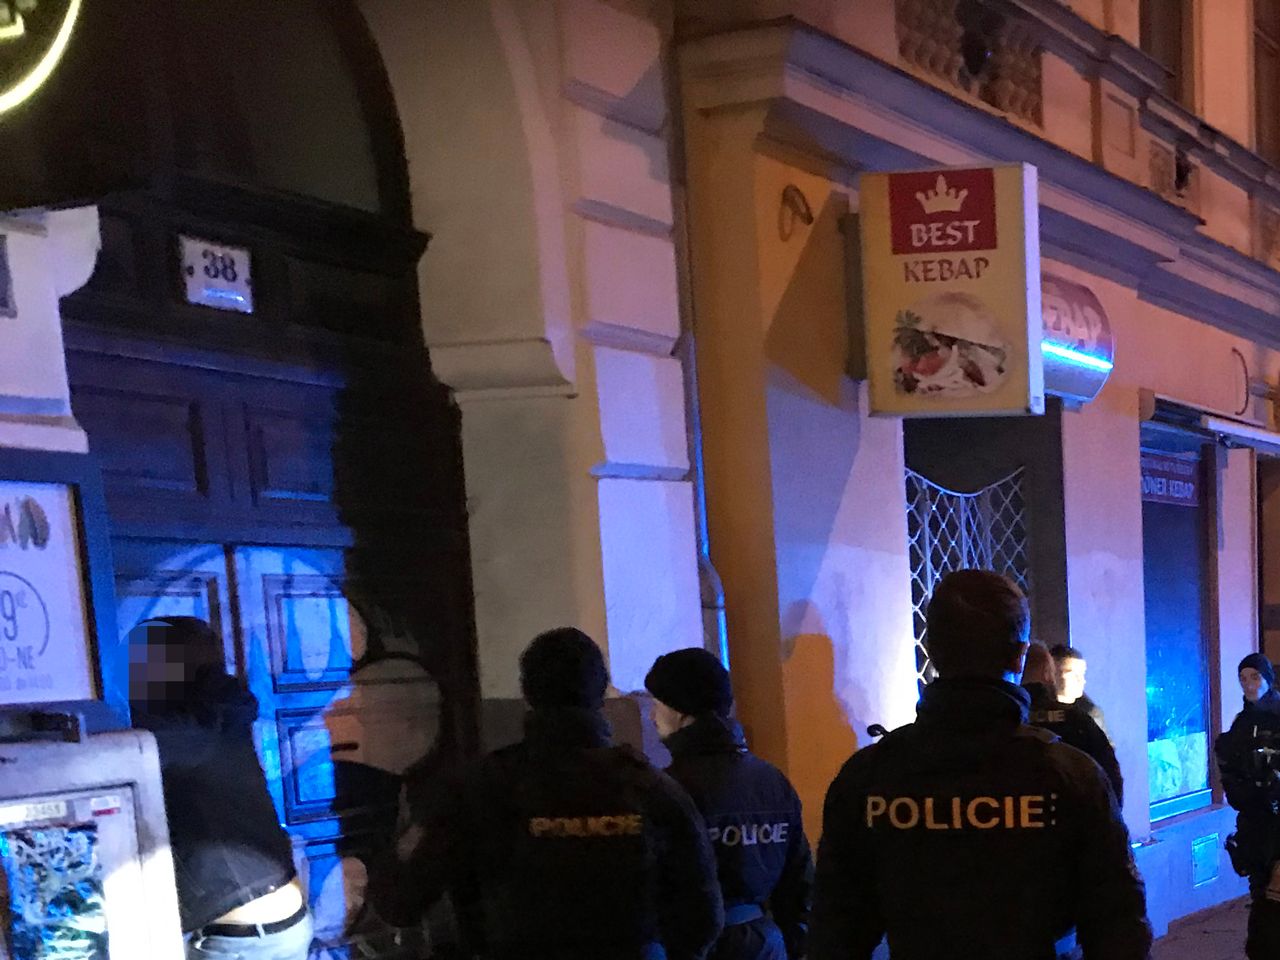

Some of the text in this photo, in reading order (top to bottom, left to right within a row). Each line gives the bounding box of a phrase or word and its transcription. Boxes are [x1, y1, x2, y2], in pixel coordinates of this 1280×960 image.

[909, 220, 981, 247] BEST
[202, 249, 237, 282] 38
[903, 257, 989, 283] KEBAP
[865, 795, 1045, 829] POLICIE
[708, 822, 789, 846] POLICIE
